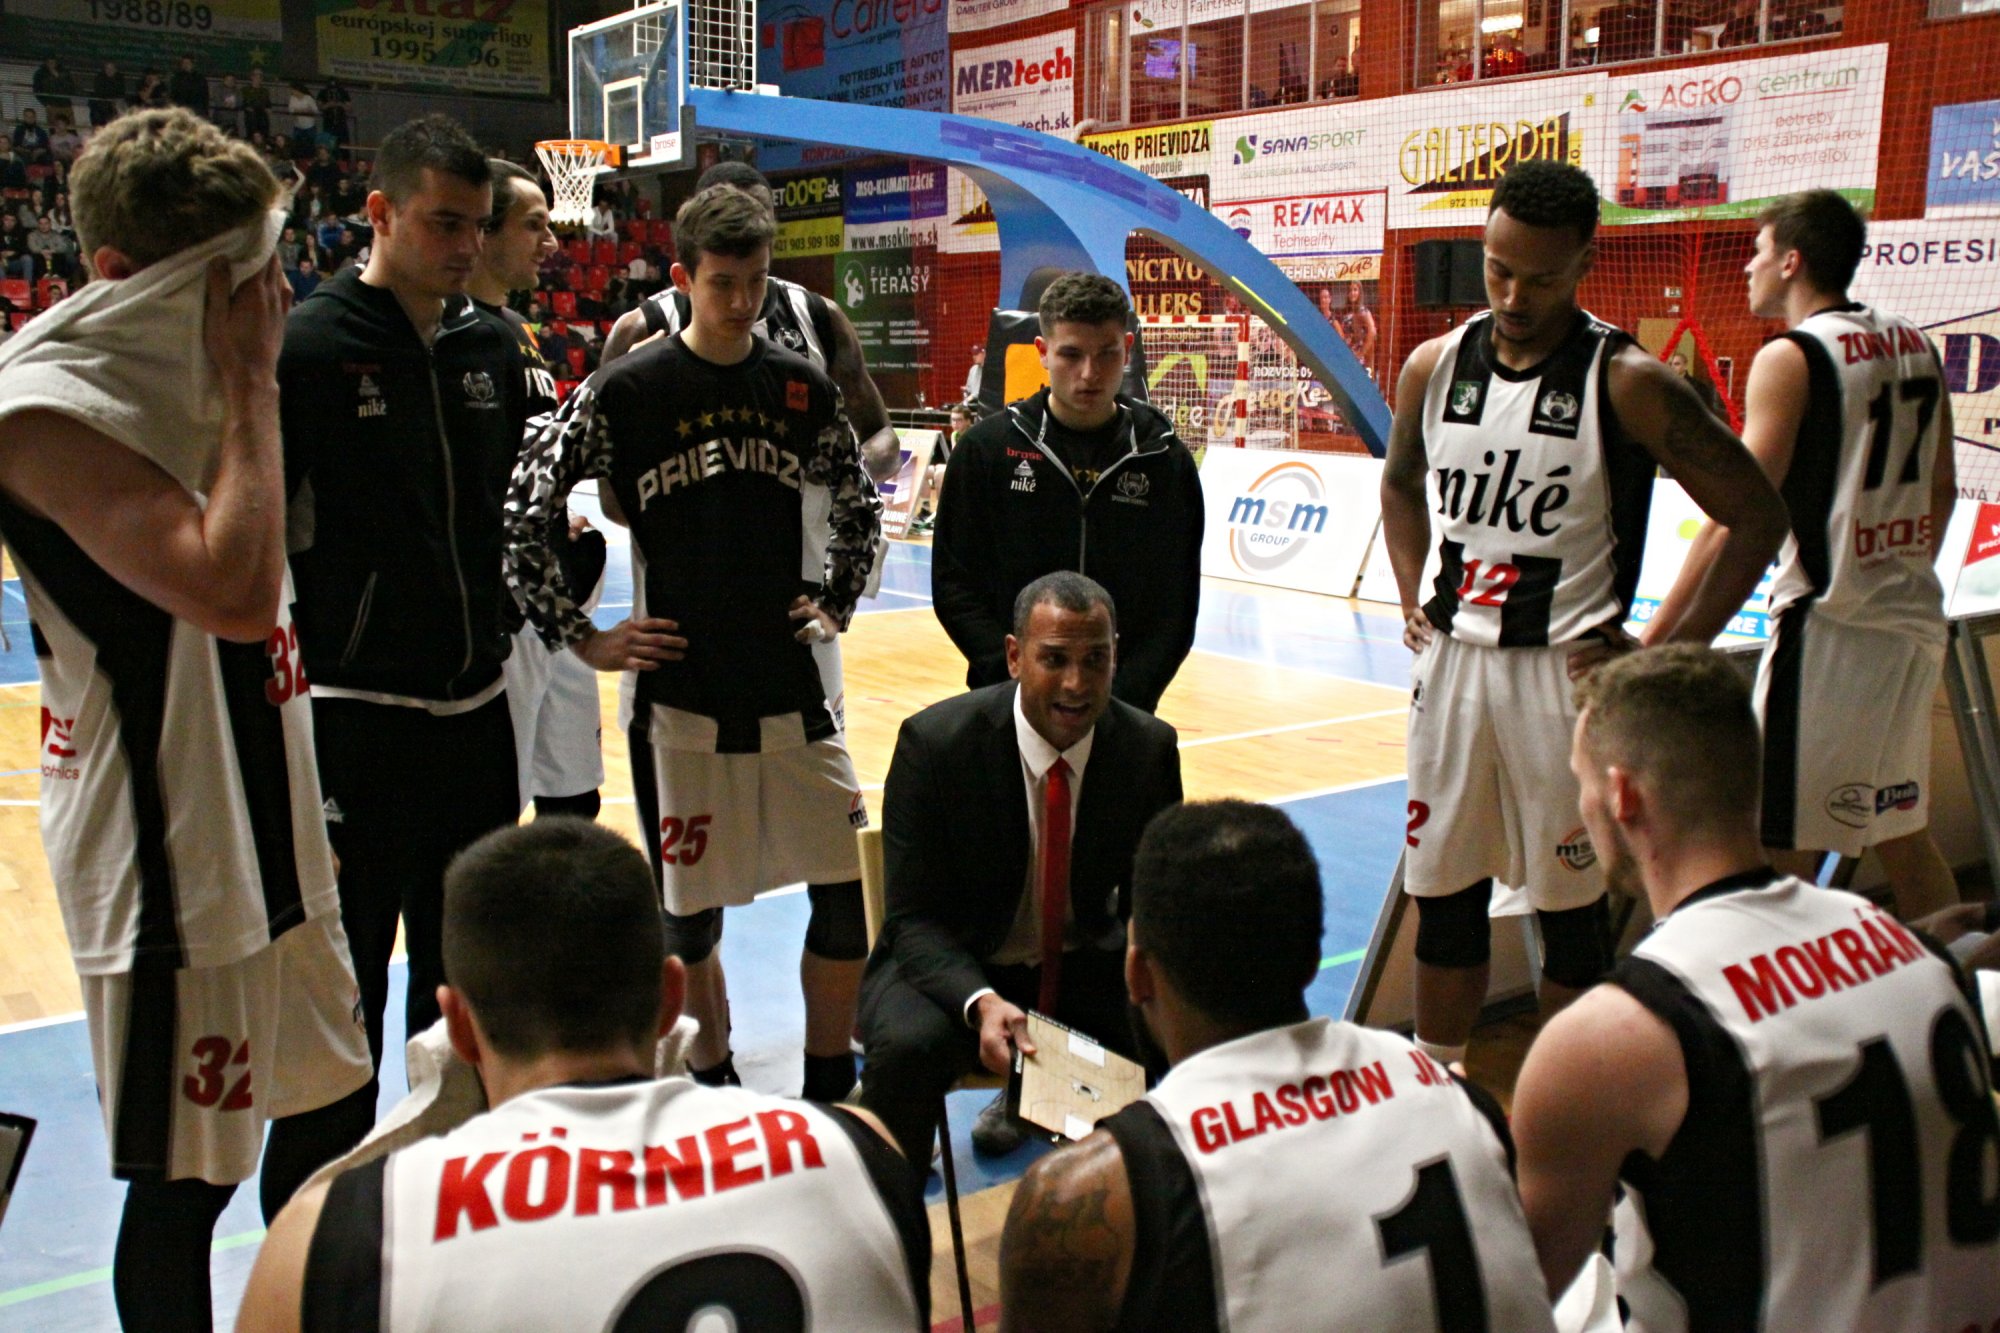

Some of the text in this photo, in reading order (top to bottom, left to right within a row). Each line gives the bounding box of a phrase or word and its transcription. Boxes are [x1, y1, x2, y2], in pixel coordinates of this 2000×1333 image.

[330, 14, 435, 39] európskej
[370, 37, 436, 63] 1995
[468, 45, 500, 68] 96
[839, 49, 945, 86] POTREBUJETE AUTO?
[956, 46, 1073, 96] MERtech
[1657, 66, 1859, 111] AGRO centrum
[1775, 111, 1836, 129] potreby
[654, 137, 677, 151] brose
[1134, 127, 1211, 160] PRIEVIDZA
[1262, 129, 1367, 155] SANASPORT
[1273, 199, 1365, 227] RE/MAX
[1449, 198, 1466, 208] 972
[1273, 231, 1335, 249] Techreality
[870, 266, 889, 276] Fit
[1125, 252, 1204, 283] NÍCTVO
[870, 274, 931, 295] TERASY
[357, 397, 387, 418] niké
[1863, 376, 1940, 492] 17
[1005, 447, 1044, 461] brose
[637, 436, 806, 513] PRIEVIDZ
[1010, 477, 1037, 493] niké
[1436, 449, 1572, 537] niké
[1228, 496, 1329, 534] msm
[1250, 533, 1290, 546] GROUP
[1456, 558, 1521, 608] 12
[661, 815, 713, 867] 25
[183, 1035, 253, 1112] 32
[1190, 1060, 1395, 1156] GLASGOW
[1811, 1004, 2000, 1293] 18
[432, 1108, 827, 1243] KÖRNER
